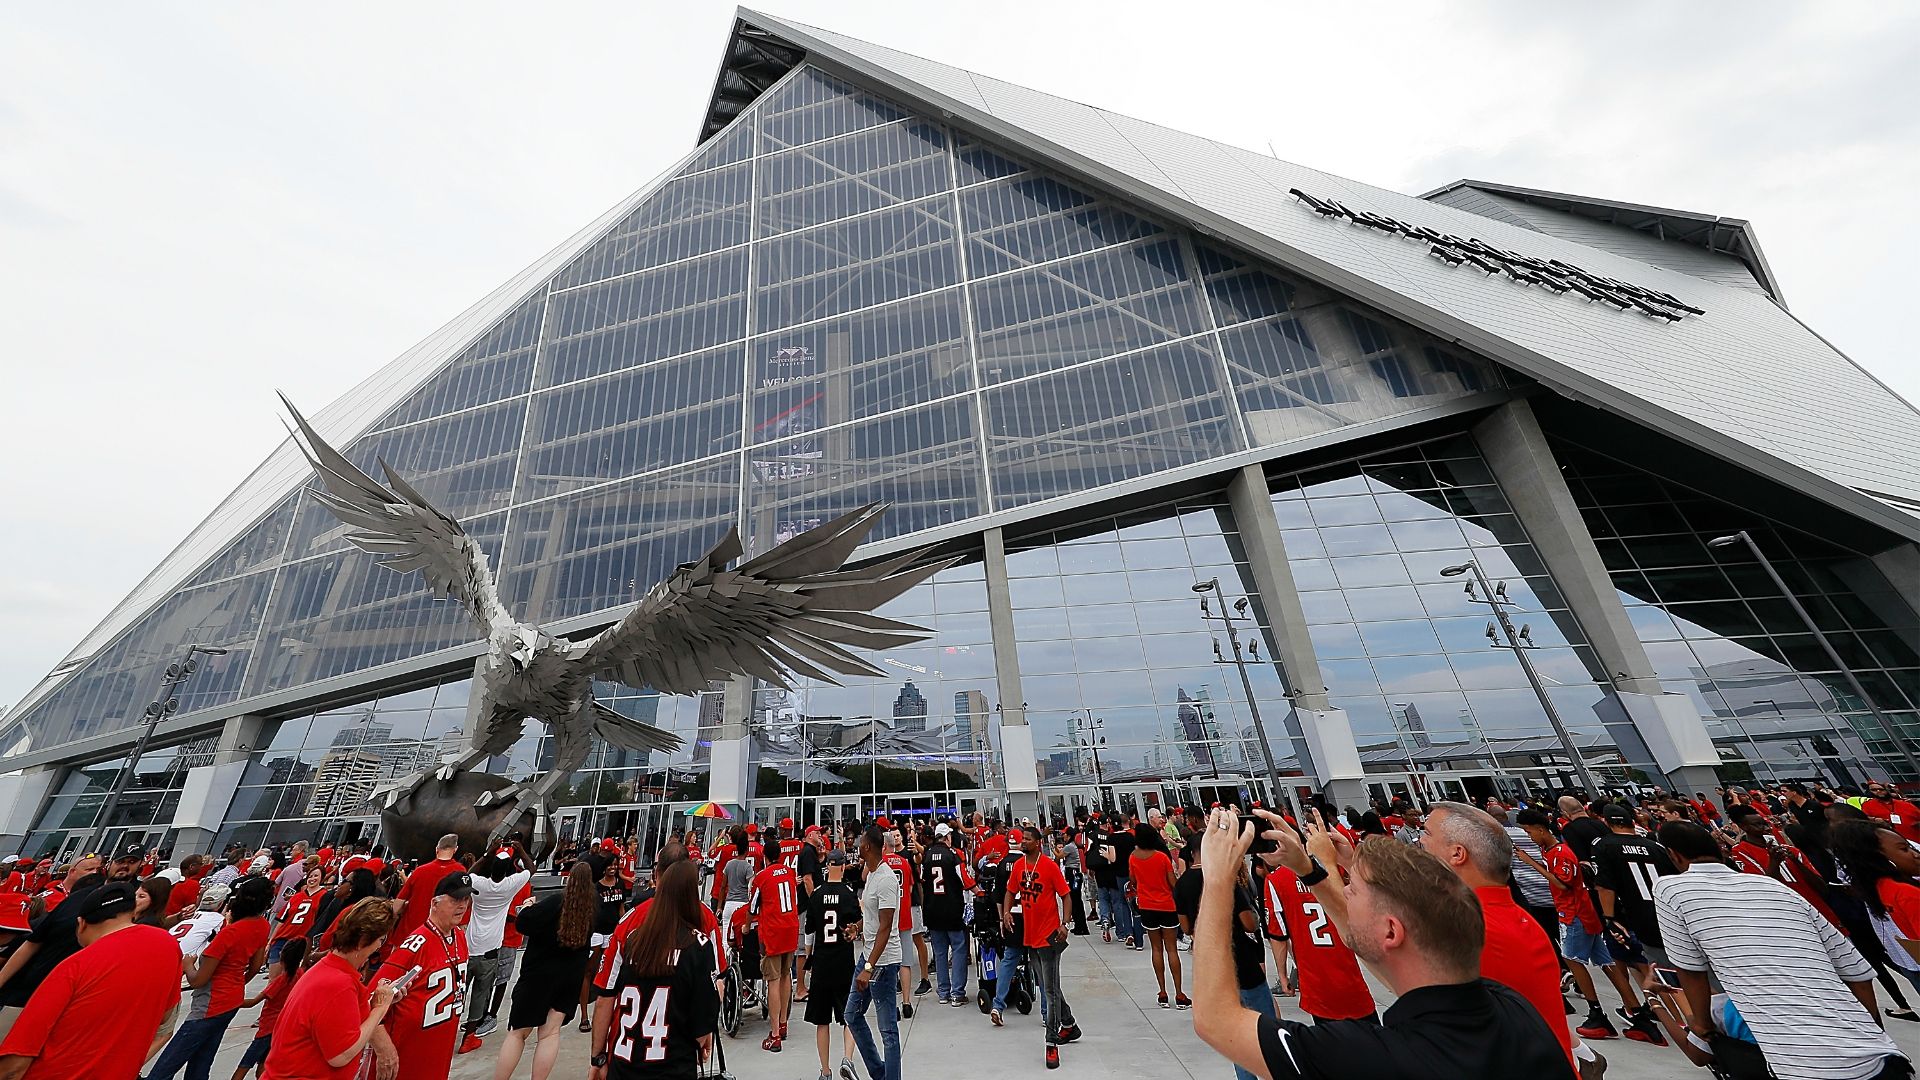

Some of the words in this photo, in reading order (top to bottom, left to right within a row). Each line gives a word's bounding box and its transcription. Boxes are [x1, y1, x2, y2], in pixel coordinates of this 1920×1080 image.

[1622, 844, 1649, 856] JONES
[772, 867, 788, 877] JONES
[931, 866, 945, 893] 2
[1627, 861, 1660, 901] 11
[777, 881, 793, 913] 11
[823, 894, 839, 904] RYAN
[291, 902, 312, 924] 2
[823, 909, 838, 943] 2
[1302, 902, 1334, 946] 2
[400, 934, 427, 953] 28
[613, 985, 671, 1062] 24
